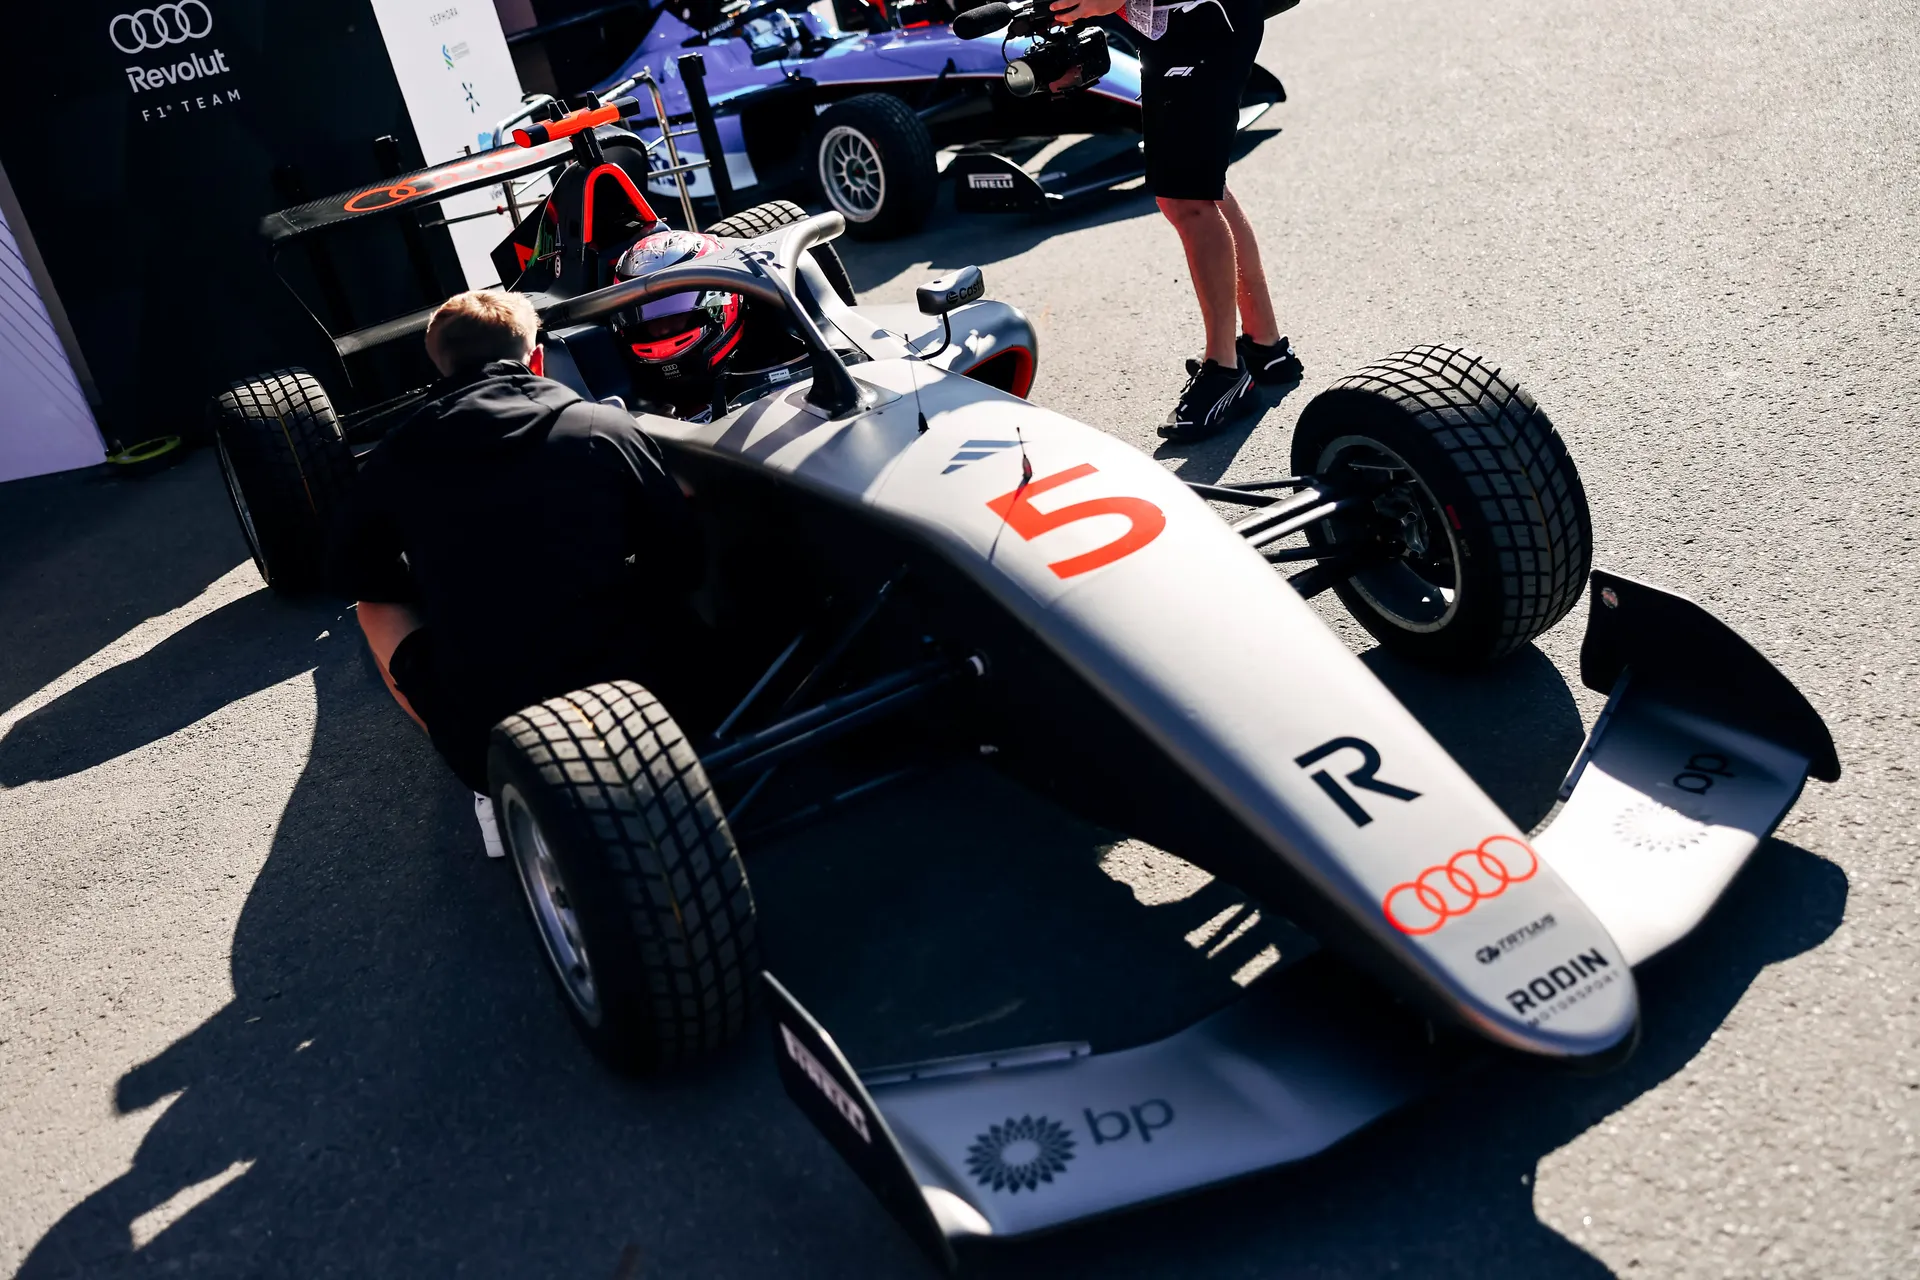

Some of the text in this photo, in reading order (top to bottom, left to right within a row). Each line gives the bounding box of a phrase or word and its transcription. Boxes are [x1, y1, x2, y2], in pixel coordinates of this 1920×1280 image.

[125, 49, 230, 93] Revolut
[1163, 66, 1195, 77] F1
[181, 89, 241, 113] TEAM
[968, 173, 1014, 189] PIRELLI
[985, 462, 1167, 580] 5
[1292, 736, 1424, 828] R
[1505, 947, 1610, 1015] RODIN
[1527, 968, 1620, 1029] MOTORSPORT
[1083, 1098, 1175, 1144] bp
